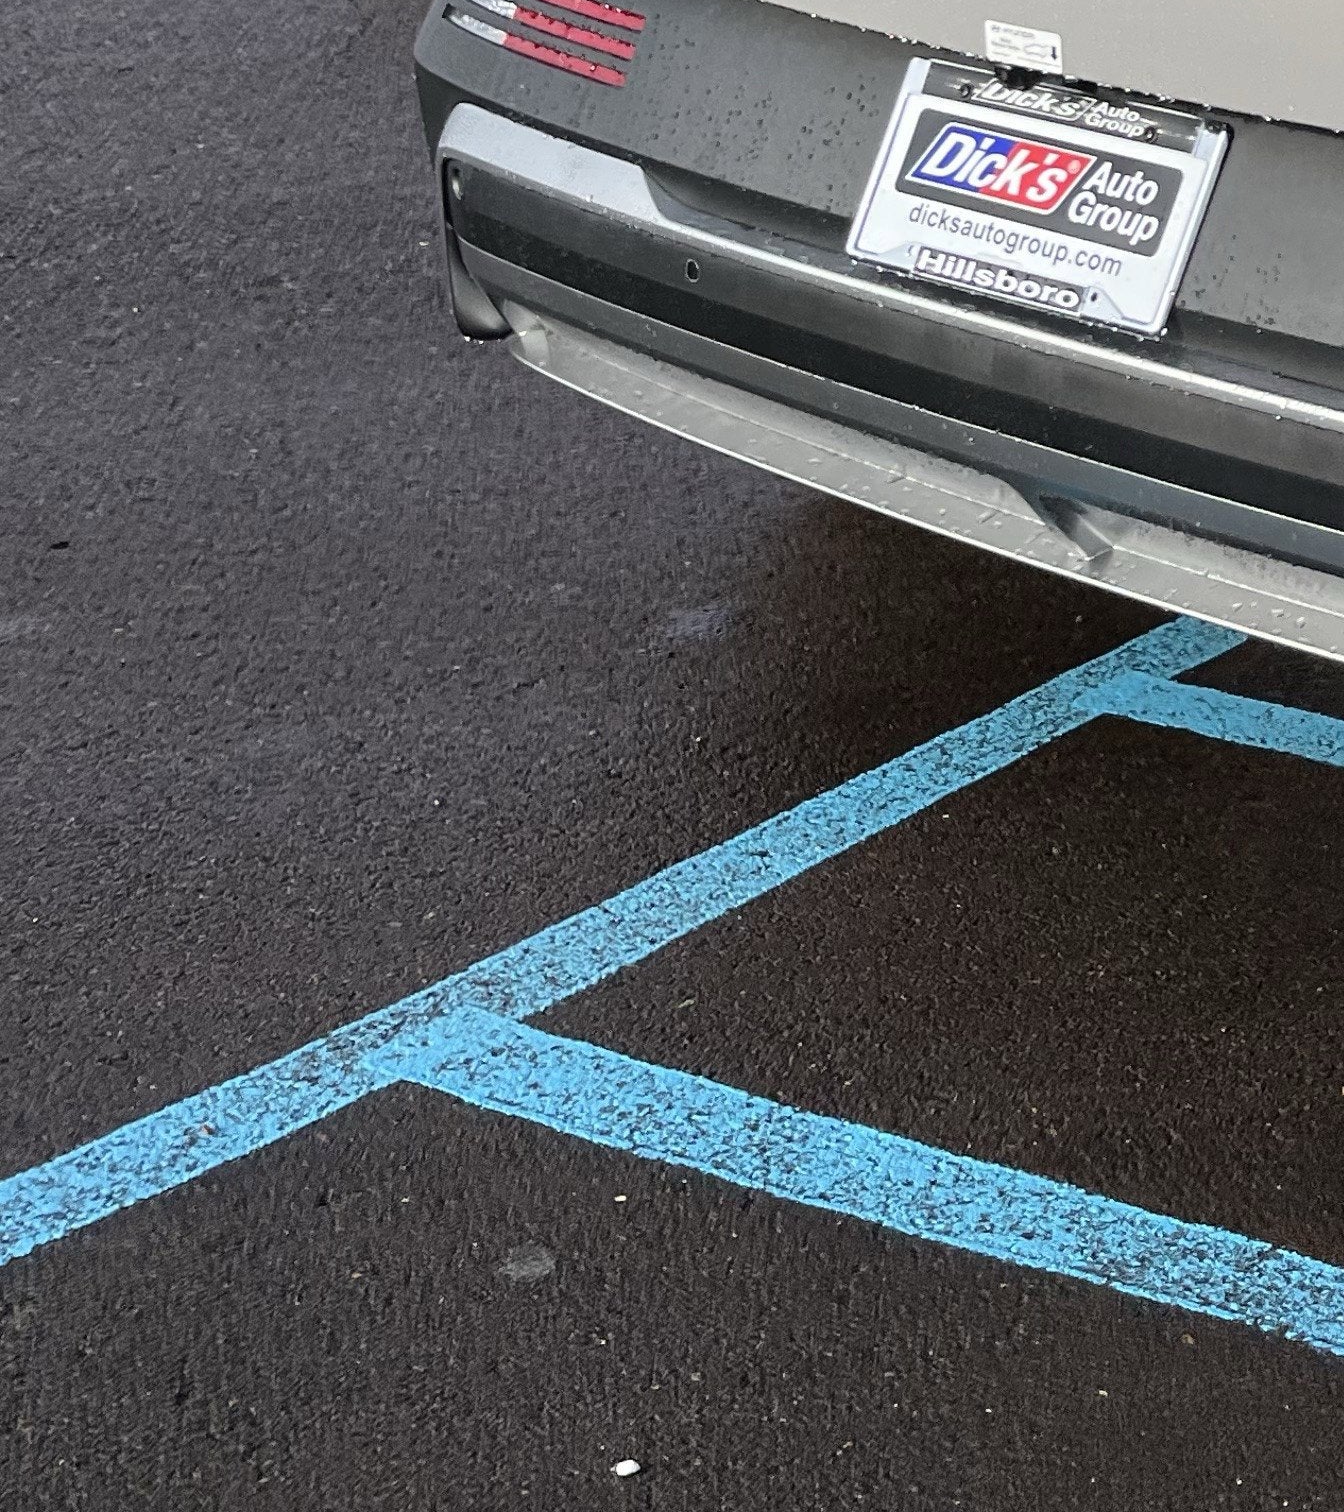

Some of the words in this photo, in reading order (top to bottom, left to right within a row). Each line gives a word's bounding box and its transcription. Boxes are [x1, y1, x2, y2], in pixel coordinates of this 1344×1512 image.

[1084, 110, 1145, 138] Group
[1092, 101, 1141, 123] Auto
[919, 132, 1068, 203] Dick's
[1081, 161, 1159, 206] Auto
[909, 202, 1122, 277] dicksautogroup.com
[1067, 191, 1159, 246] Group
[916, 248, 1081, 309] Hillsboro
